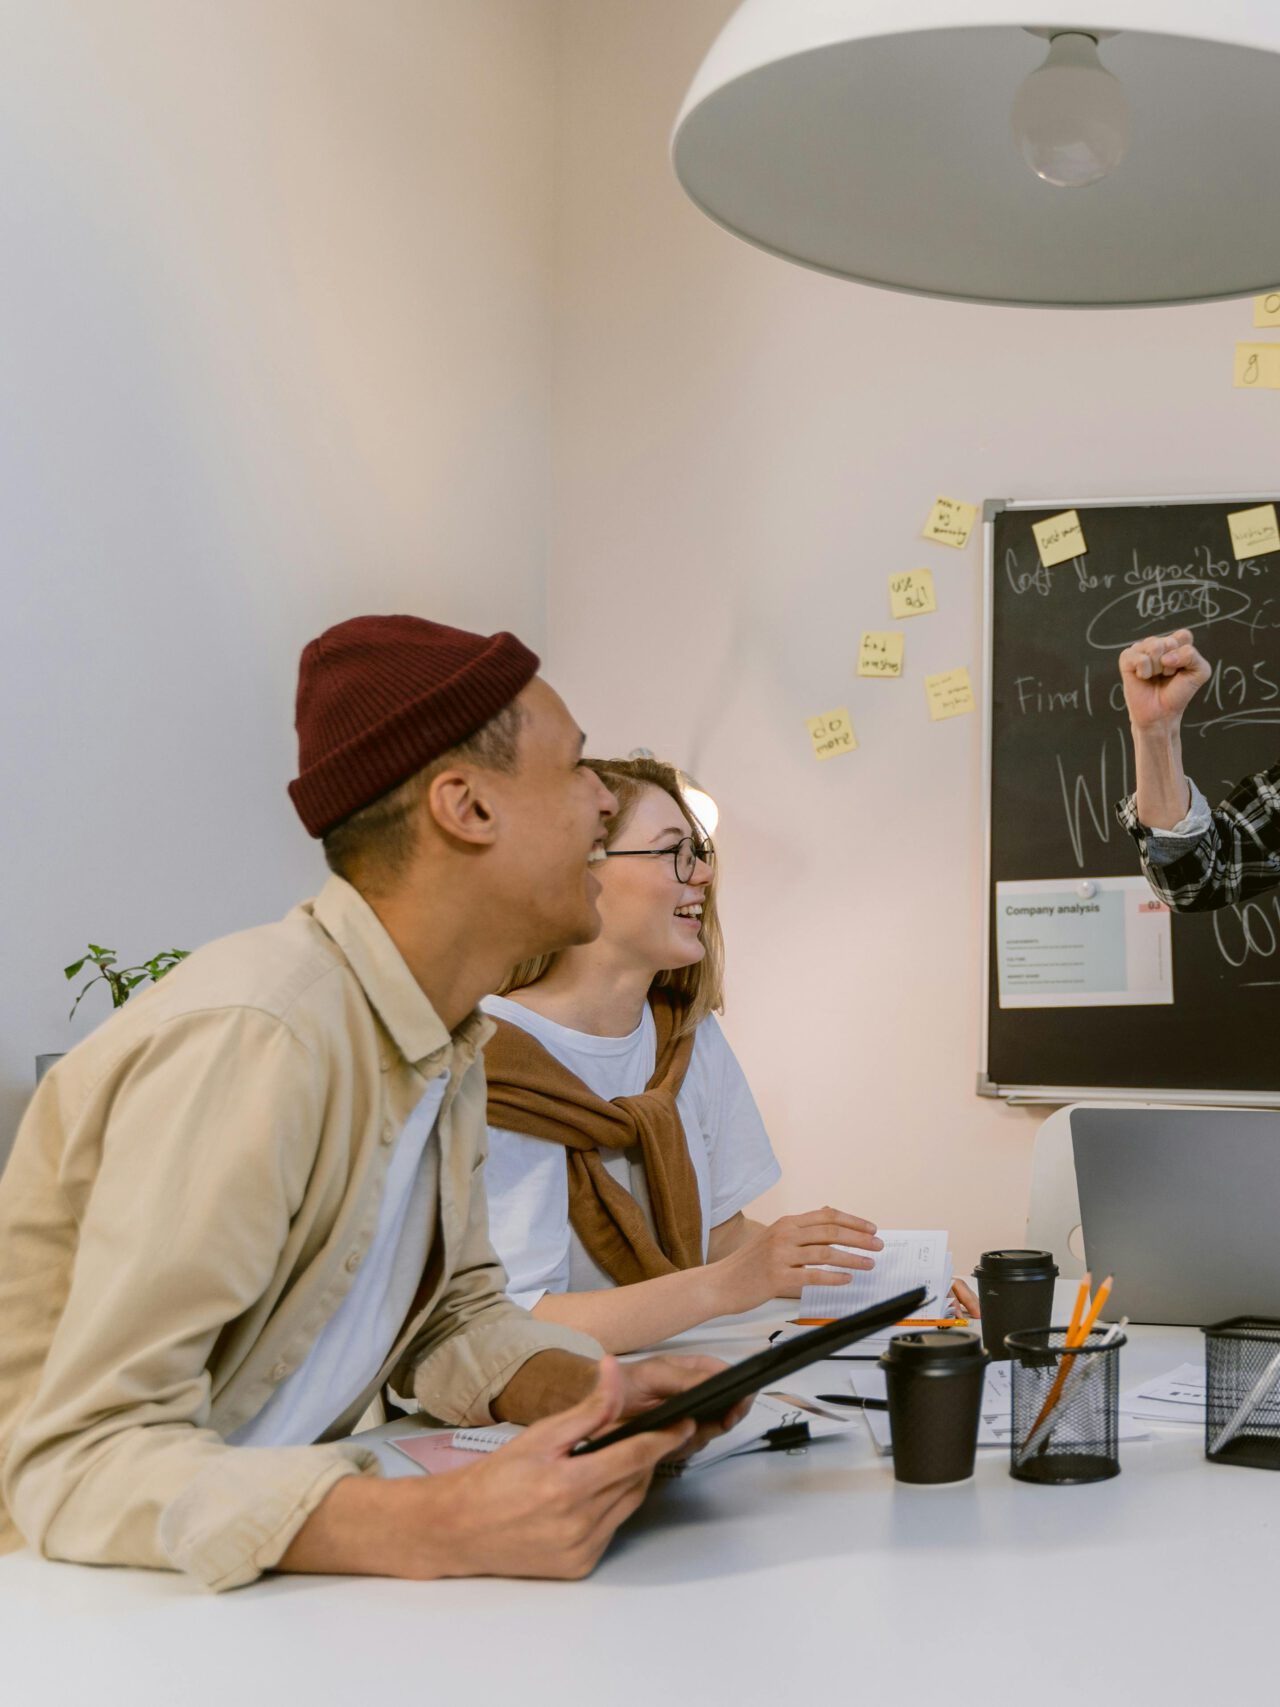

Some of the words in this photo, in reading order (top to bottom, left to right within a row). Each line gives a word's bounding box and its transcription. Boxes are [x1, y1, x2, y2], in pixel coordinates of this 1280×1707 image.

[1014, 664, 1094, 717] Final
[812, 716, 843, 740] do
[815, 731, 853, 754] more
[1005, 904, 1054, 918] Company
[1057, 902, 1101, 916] analysis
[1147, 900, 1161, 911] 03
